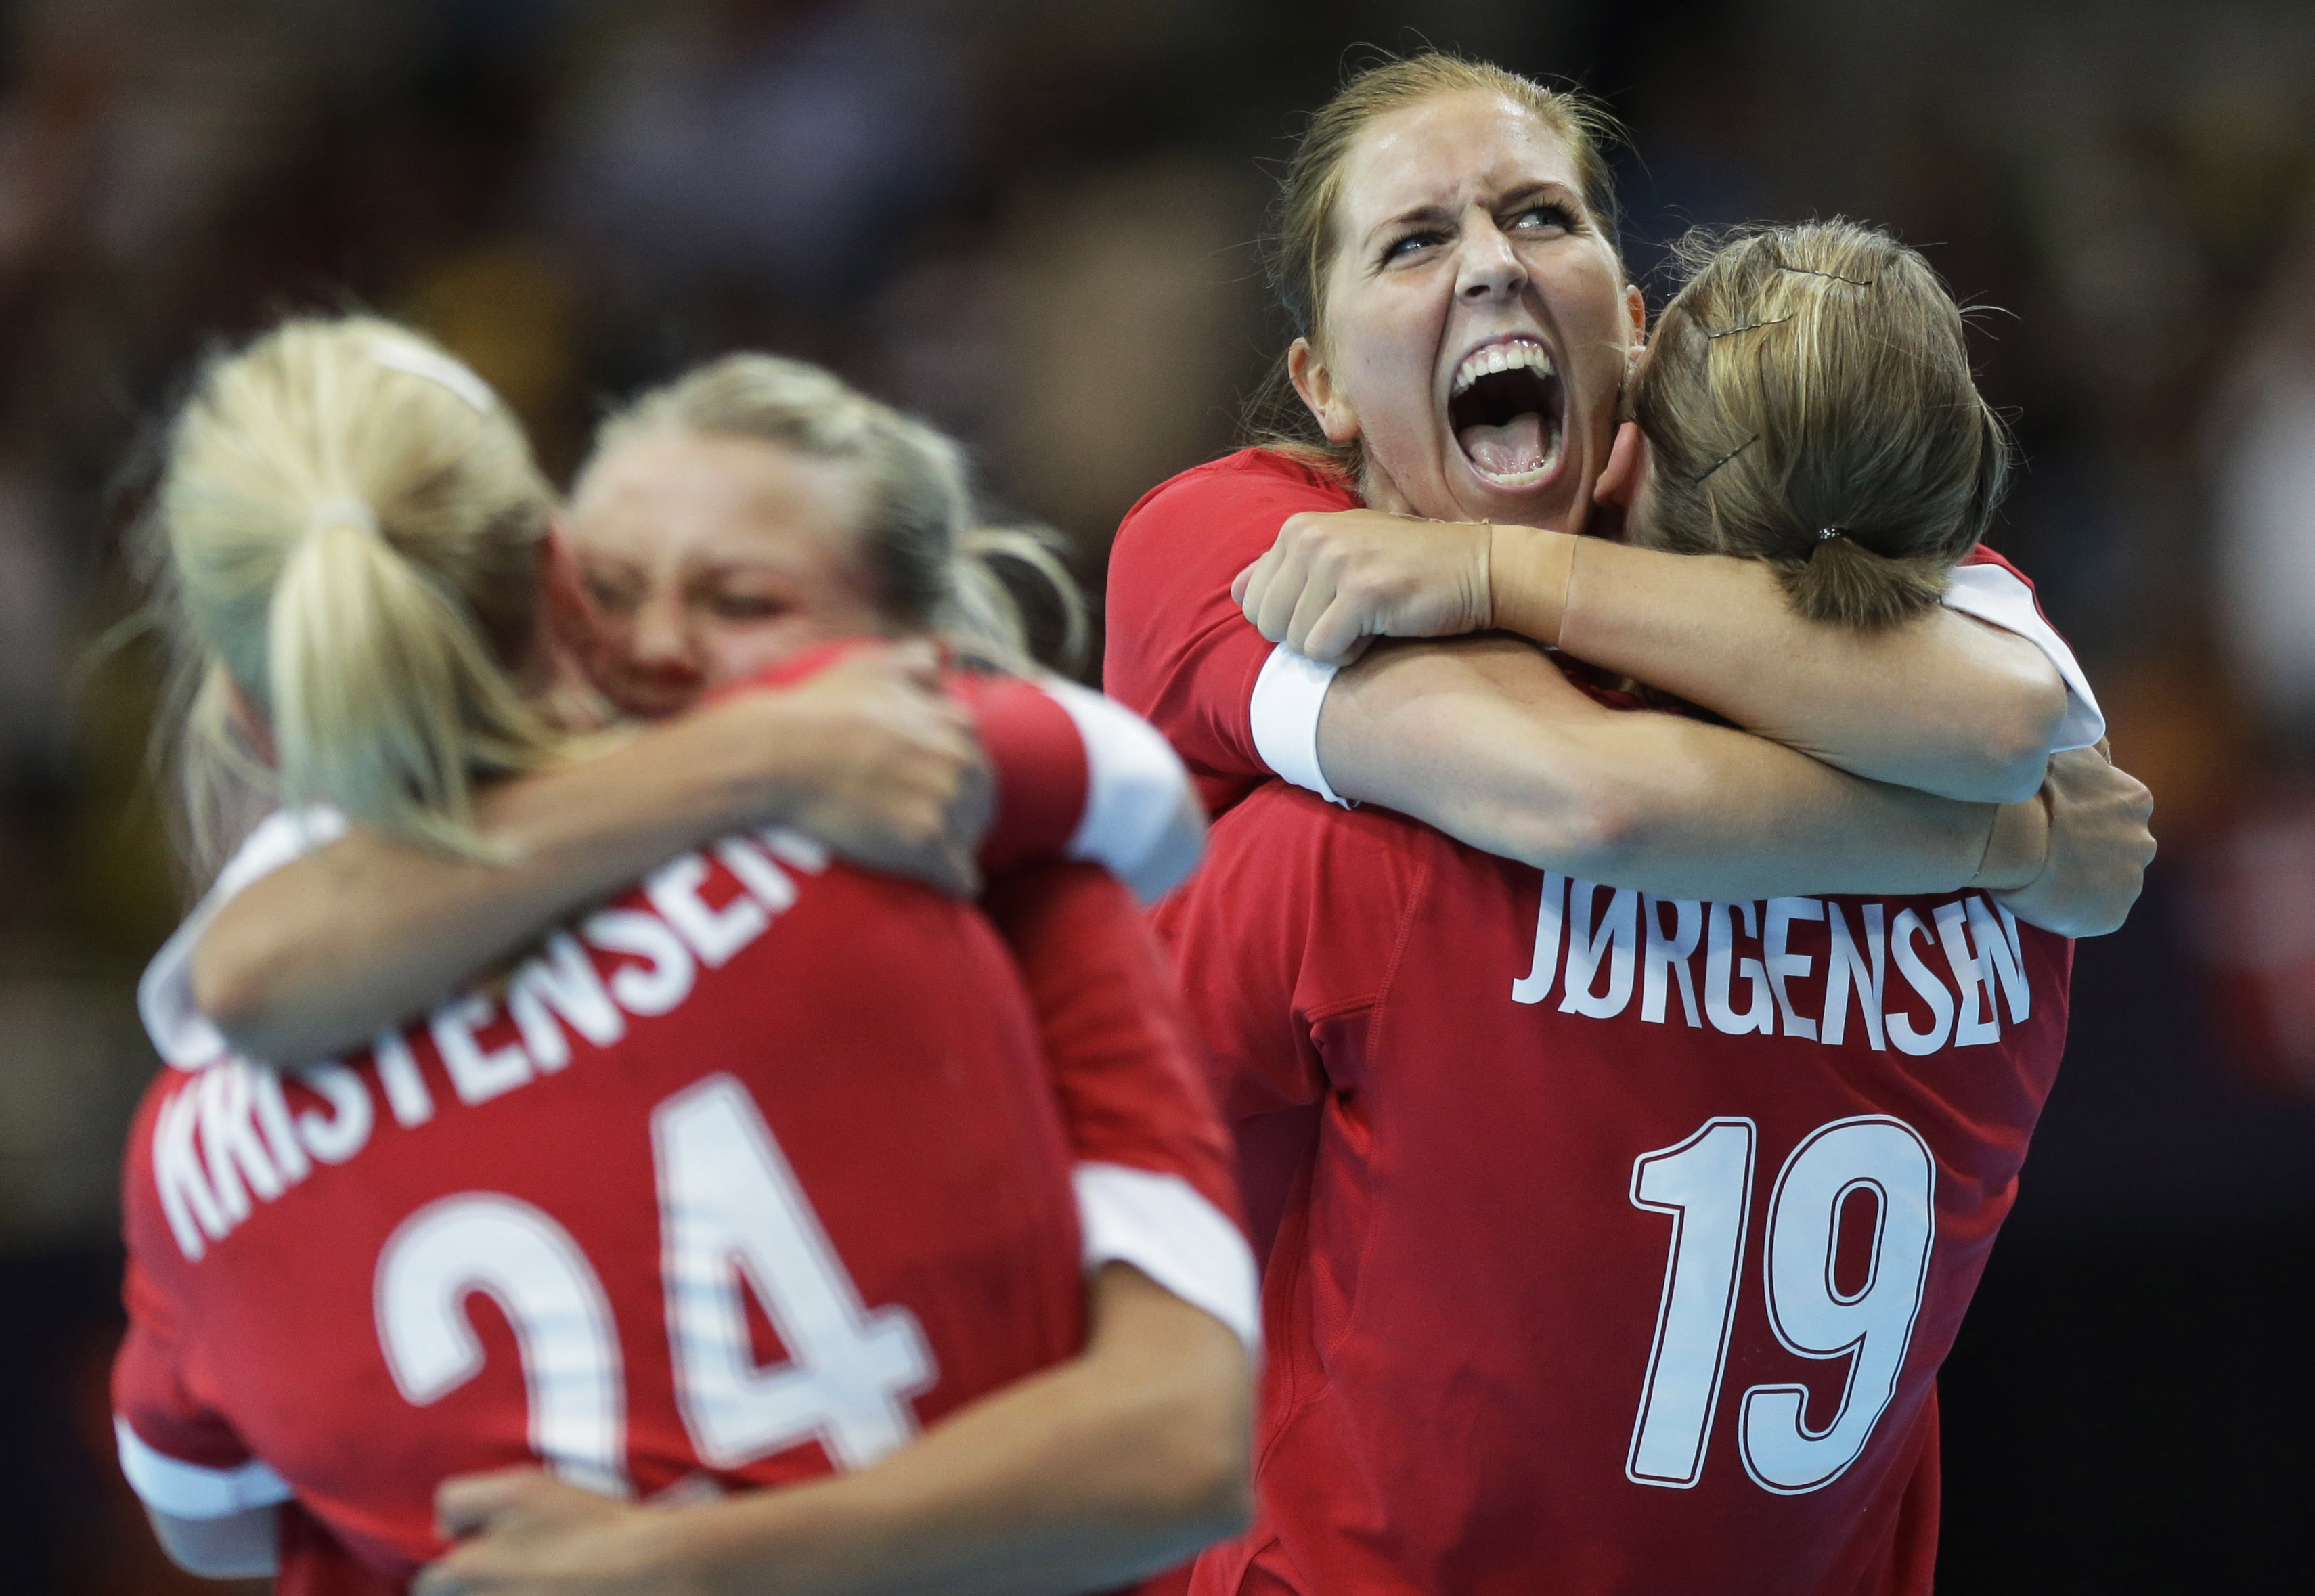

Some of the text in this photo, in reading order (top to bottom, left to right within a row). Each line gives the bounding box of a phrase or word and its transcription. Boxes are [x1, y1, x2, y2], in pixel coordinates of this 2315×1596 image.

[1511, 870, 2030, 1056] JØRGENSEN
[372, 1069, 943, 1500] 24
[1625, 1113, 1937, 1496] 19
